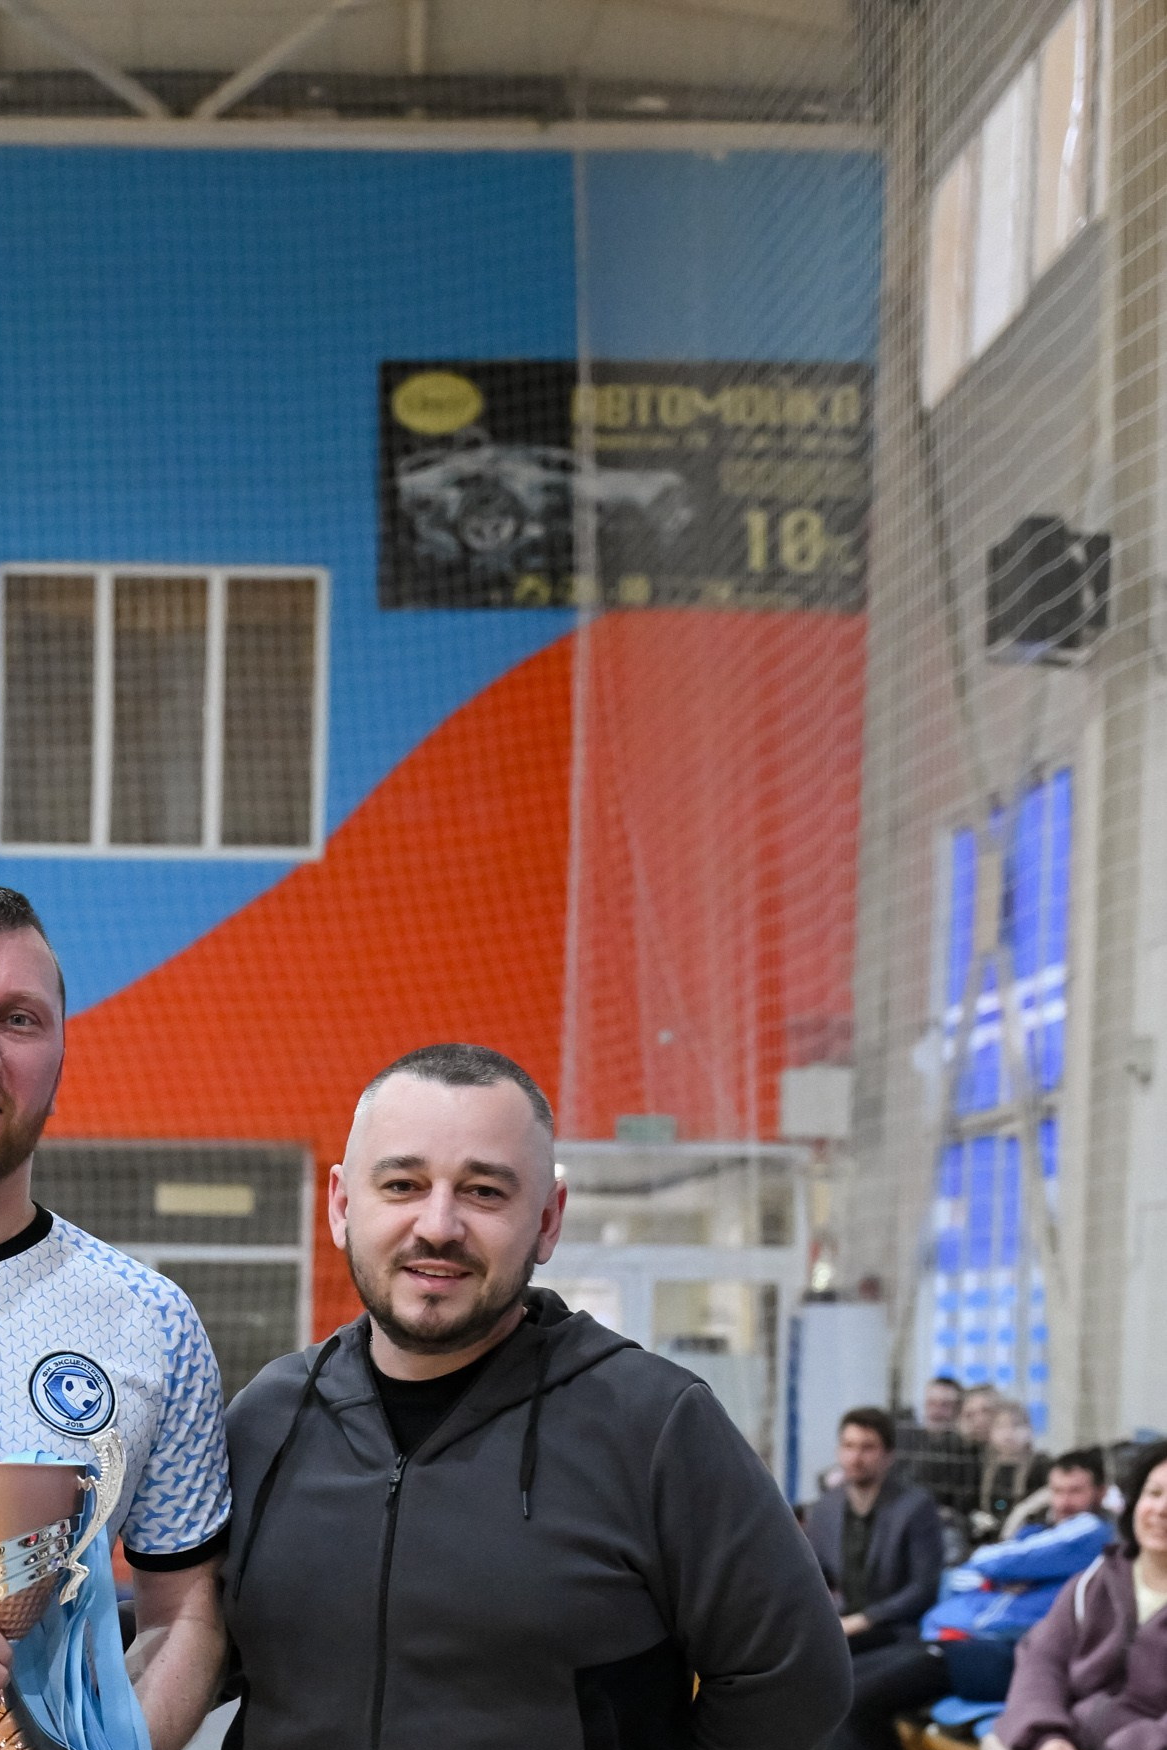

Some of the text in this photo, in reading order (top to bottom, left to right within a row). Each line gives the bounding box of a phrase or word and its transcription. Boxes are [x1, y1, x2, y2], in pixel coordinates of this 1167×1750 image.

[42, 1358, 104, 1385] ФК ЭКСЦЕНТРИК
[65, 1420, 85, 1429] 2018
